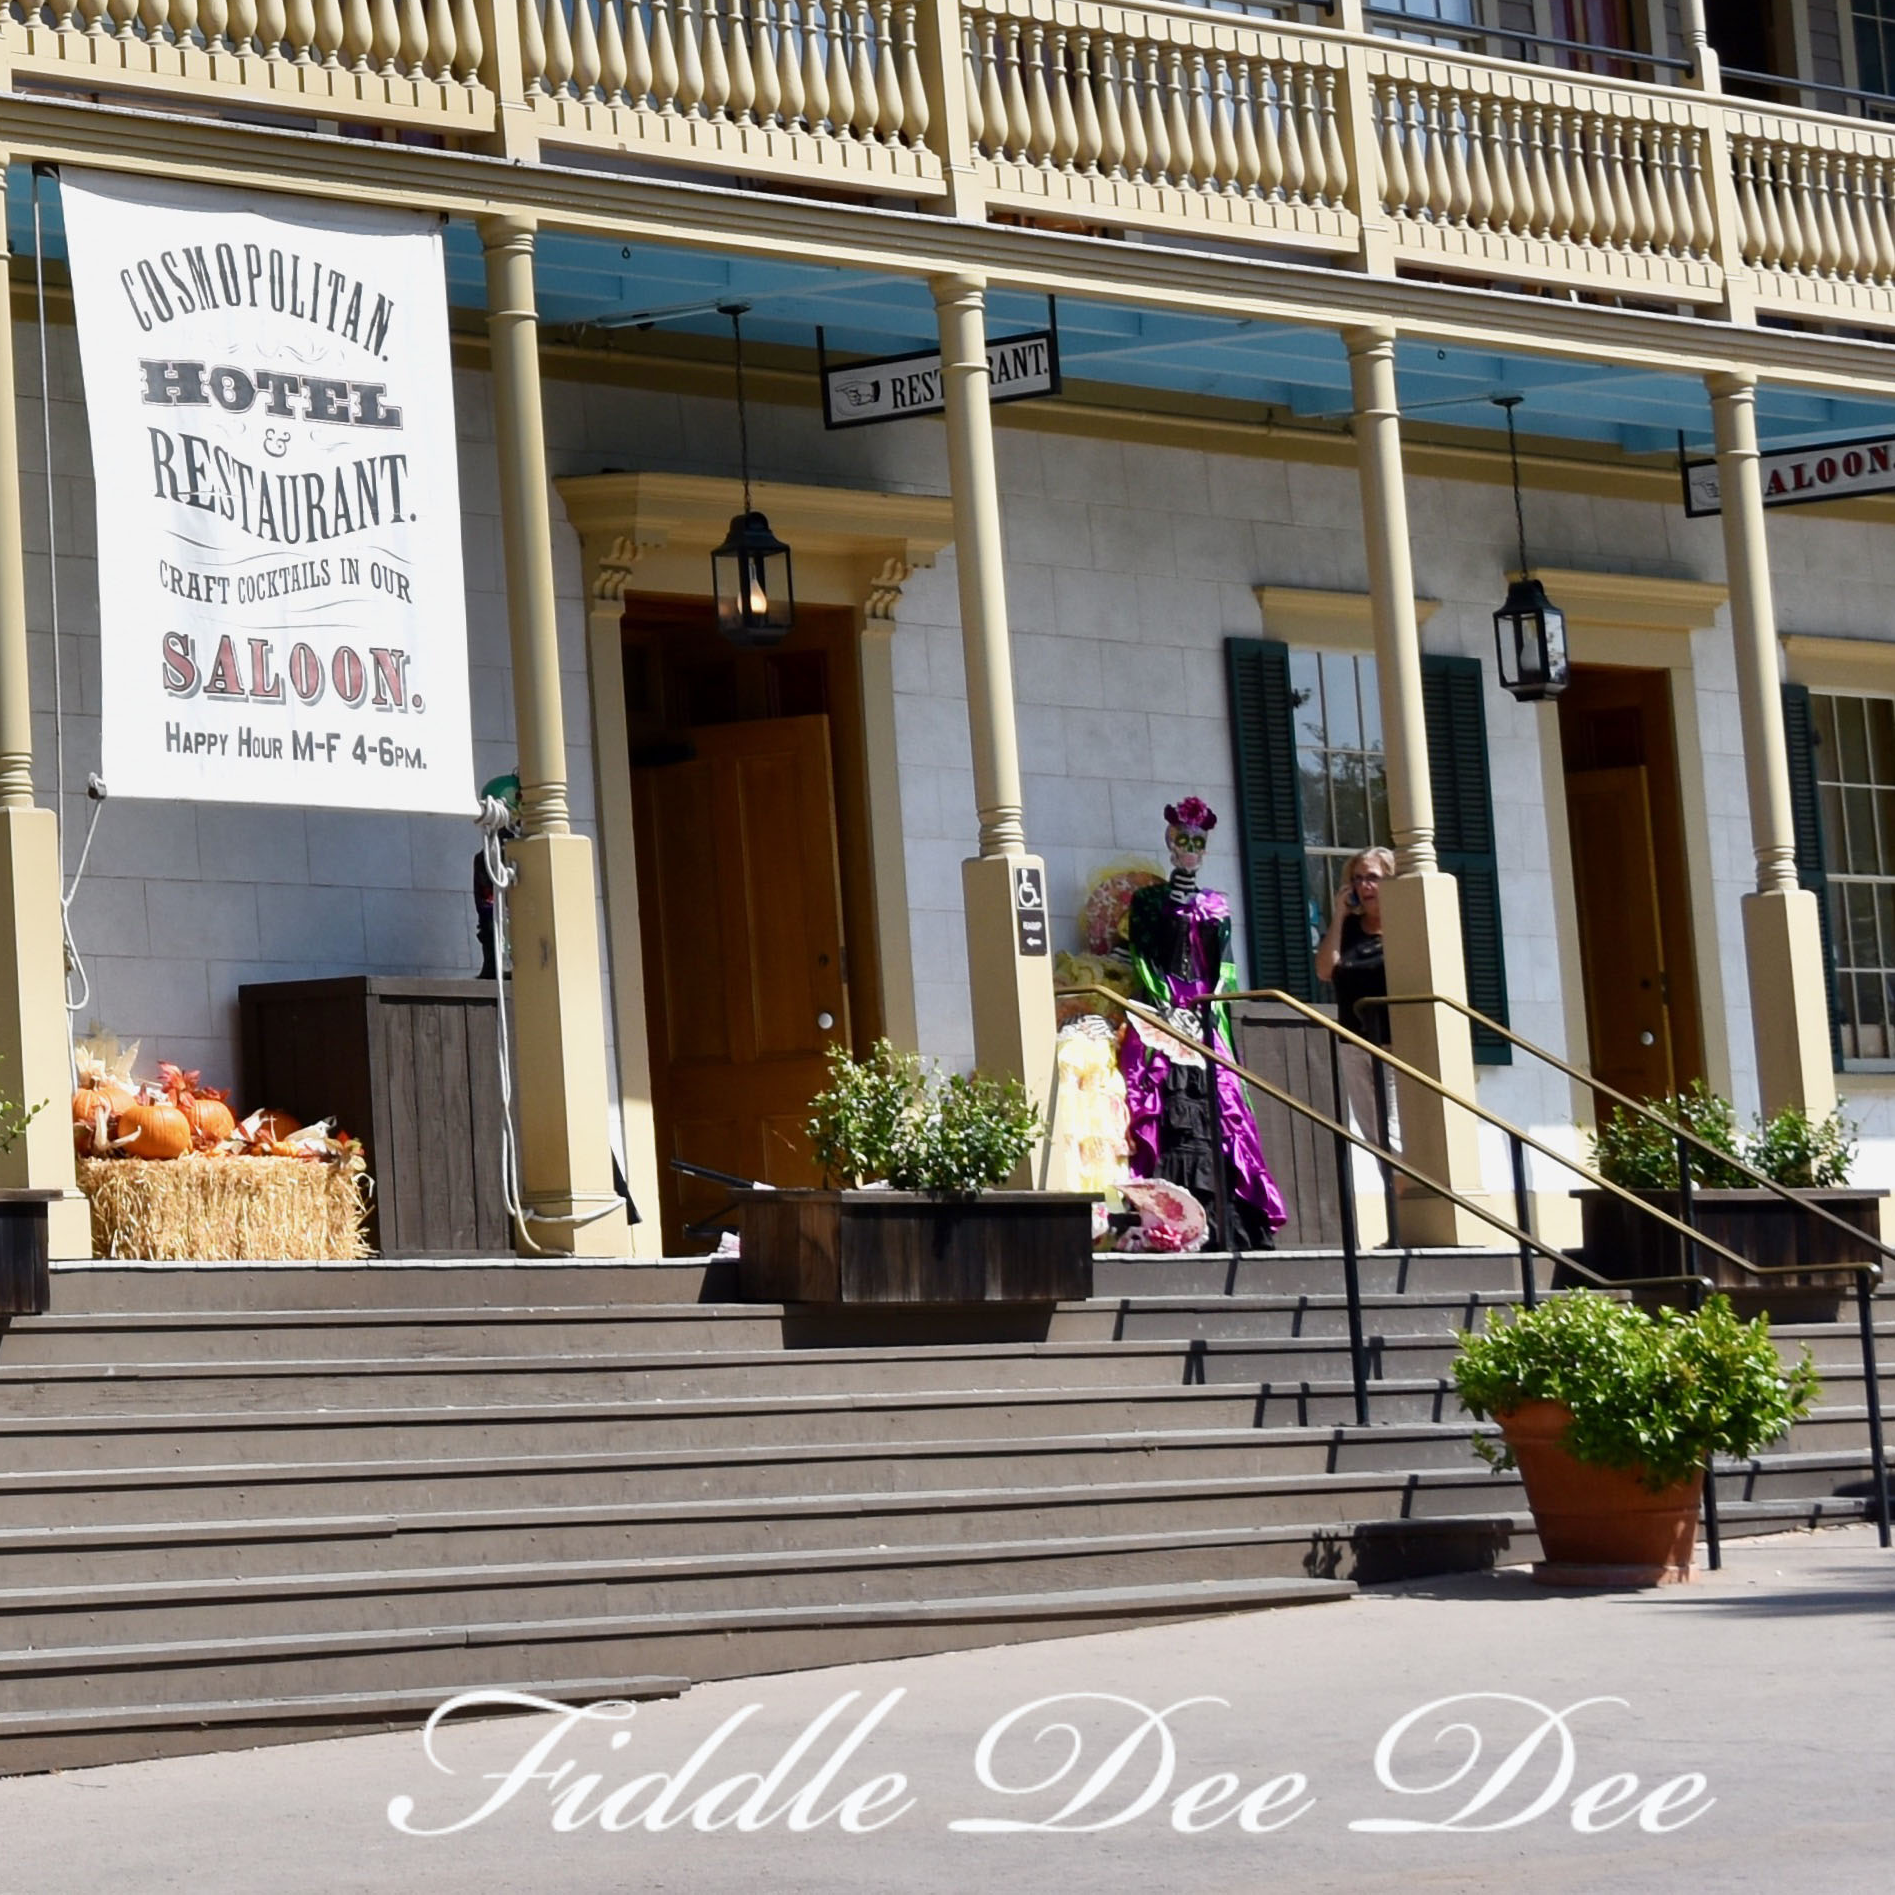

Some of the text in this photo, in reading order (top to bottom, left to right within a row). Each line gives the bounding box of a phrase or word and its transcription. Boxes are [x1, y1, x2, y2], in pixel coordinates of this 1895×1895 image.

[120, 242, 395, 363] COSMOPOLITAN.
[137, 358, 404, 430] HOTEL
[891, 343, 1049, 409] RESTRANT.
[263, 428, 290, 458] &
[1764, 445, 1895, 497] ALOON
[147, 426, 417, 545] RESTAURANT.
[159, 558, 413, 605] CRAFT COCKTAILS IN OUR
[161, 631, 425, 714] SALOON.
[165, 721, 428, 771] HAPPY HOUR M-F 4-6PM.
